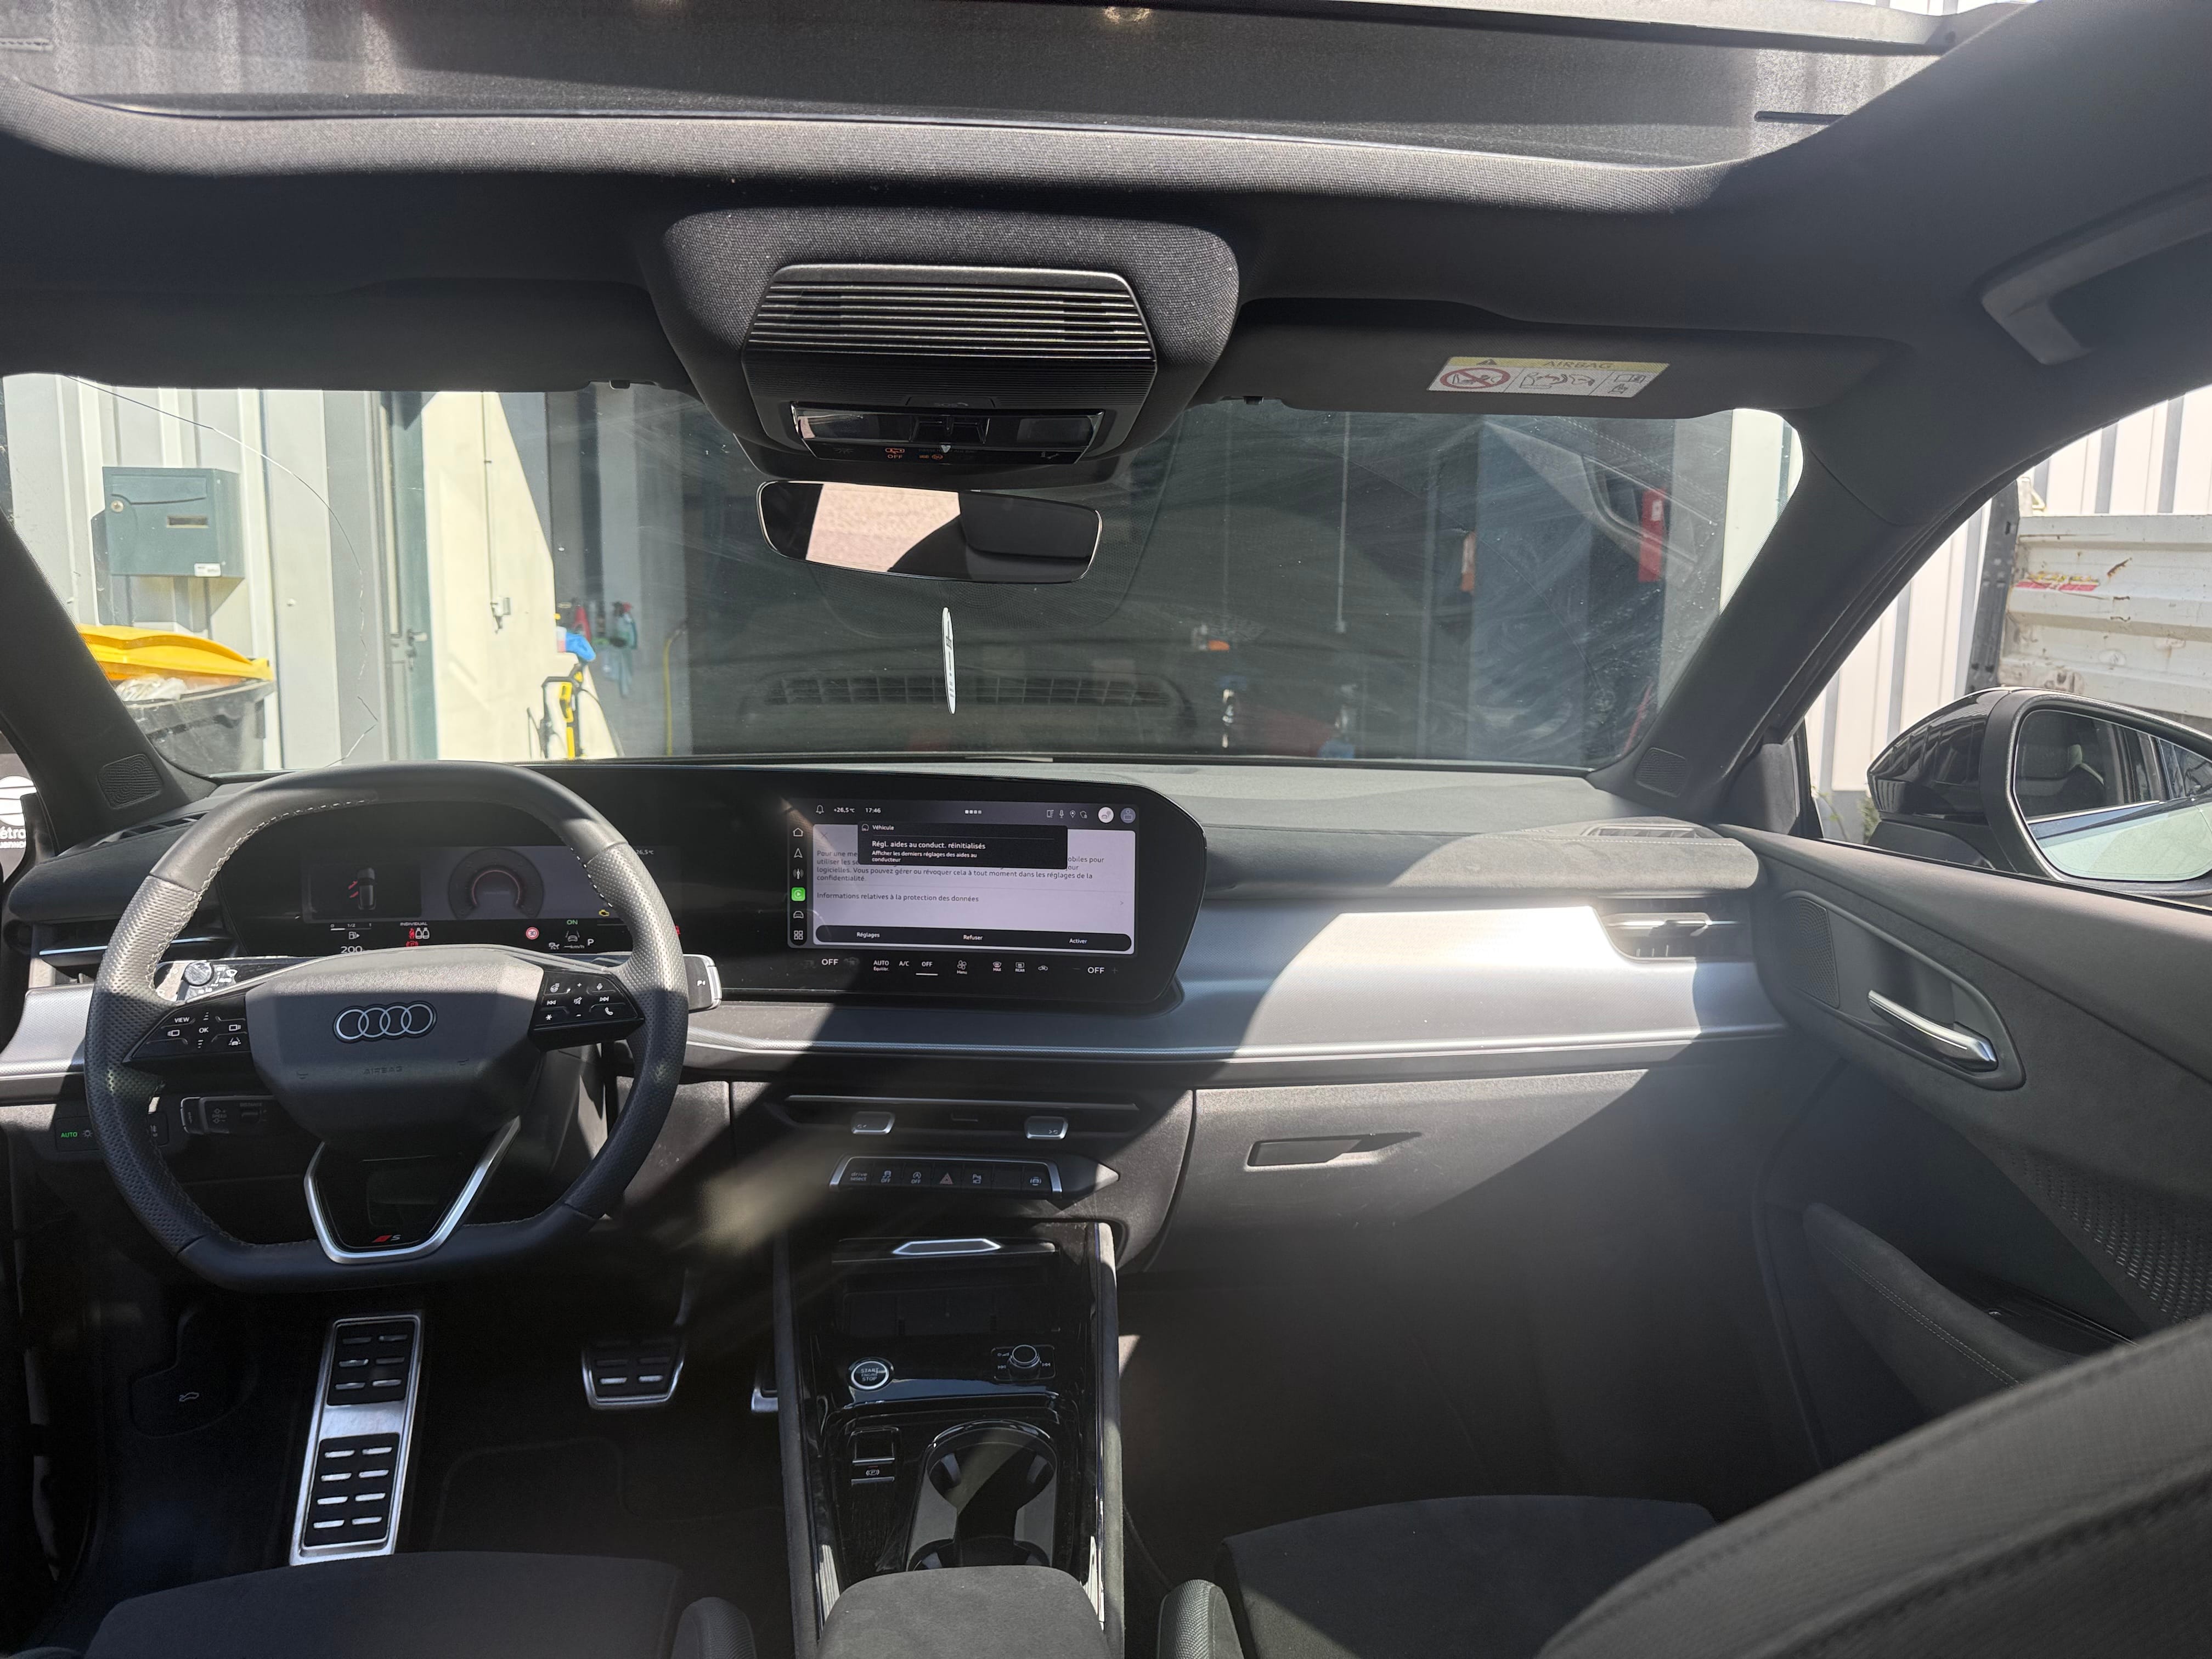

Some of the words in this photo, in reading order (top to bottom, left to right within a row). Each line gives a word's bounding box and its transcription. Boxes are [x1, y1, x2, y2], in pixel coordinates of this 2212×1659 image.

[1543, 360, 1614, 369] AIRBAG
[872, 840, 889, 849] Régl.
[895, 867, 912, 876] gérer
[1047, 871, 1075, 879] réglages
[340, 945, 363, 953] 200
[363, 1065, 403, 1075] AIRBAG
